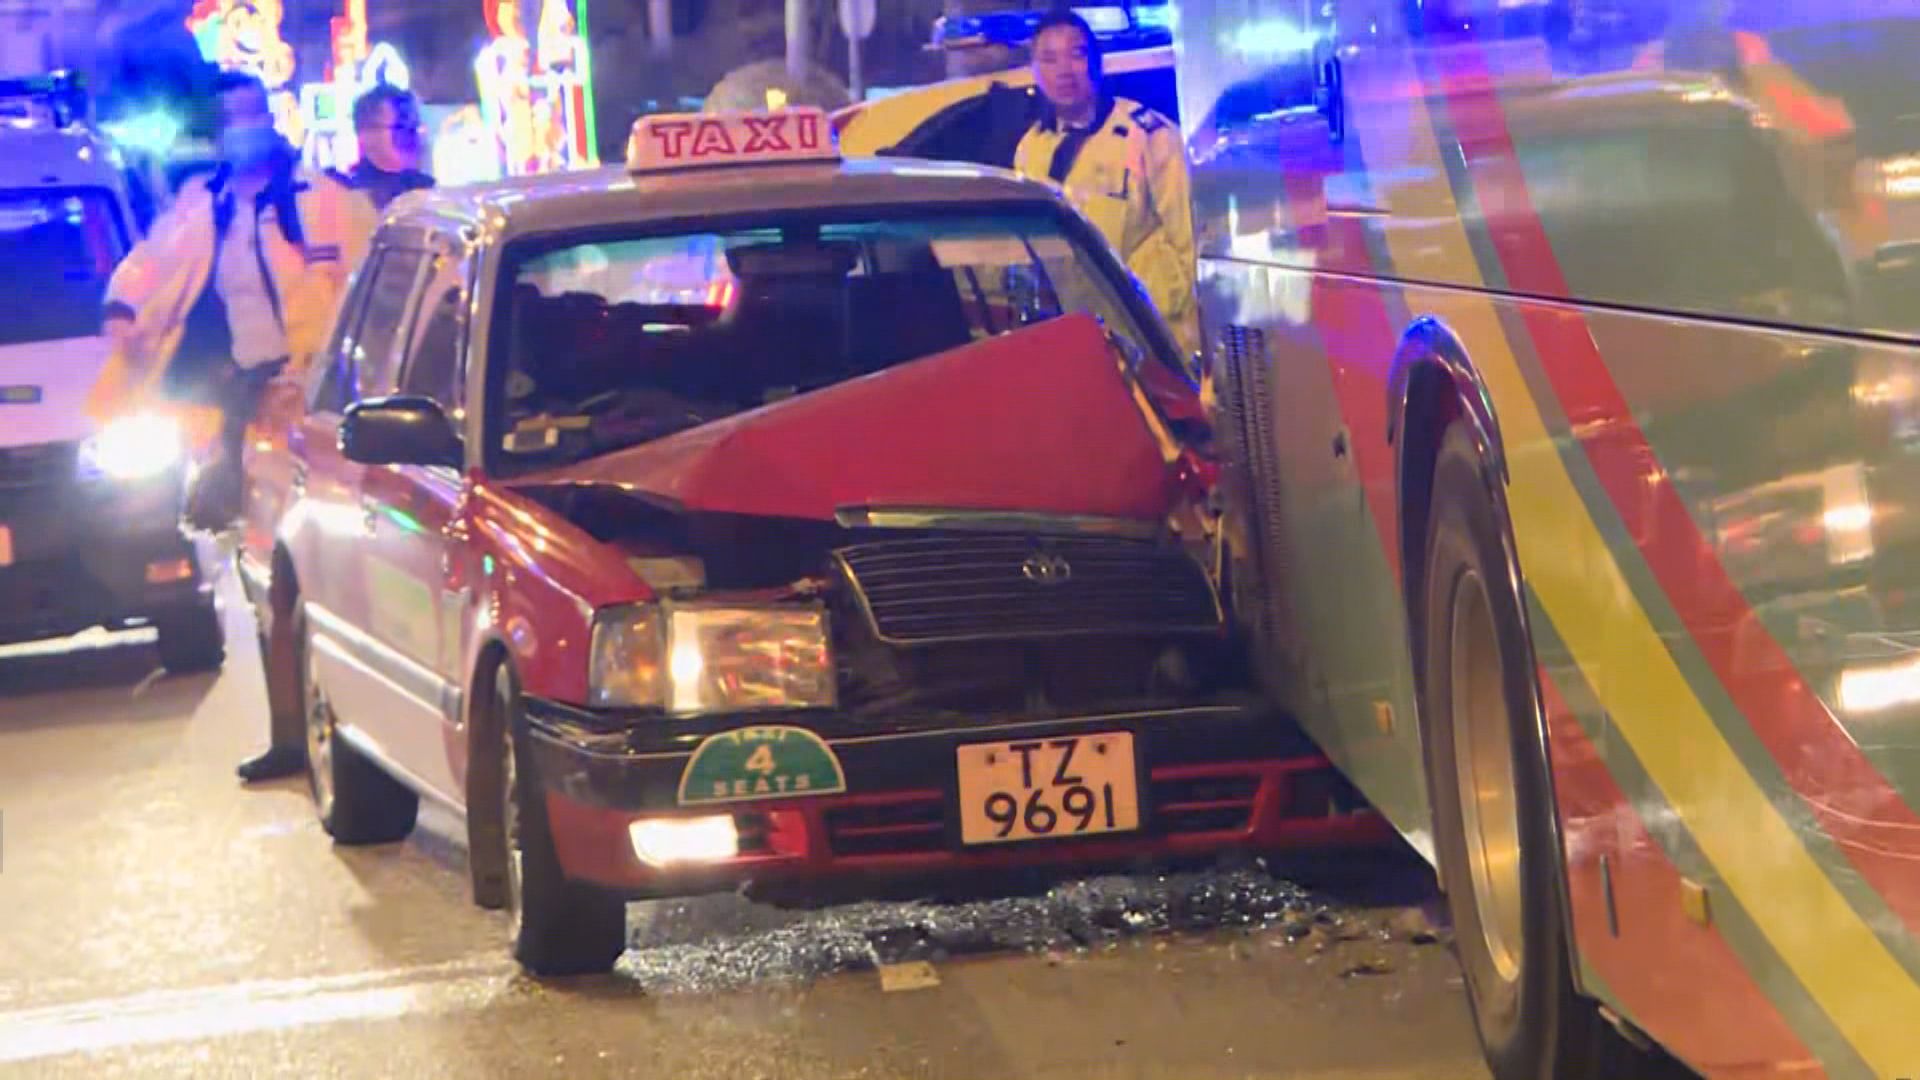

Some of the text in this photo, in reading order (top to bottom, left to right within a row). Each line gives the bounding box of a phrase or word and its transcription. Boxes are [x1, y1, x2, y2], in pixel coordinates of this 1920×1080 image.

[652, 113, 818, 159] TAXI
[745, 743, 776, 775] 4
[1009, 739, 1083, 789] TZ
[713, 774, 810, 797] SEATS
[984, 781, 1115, 838] 9691
